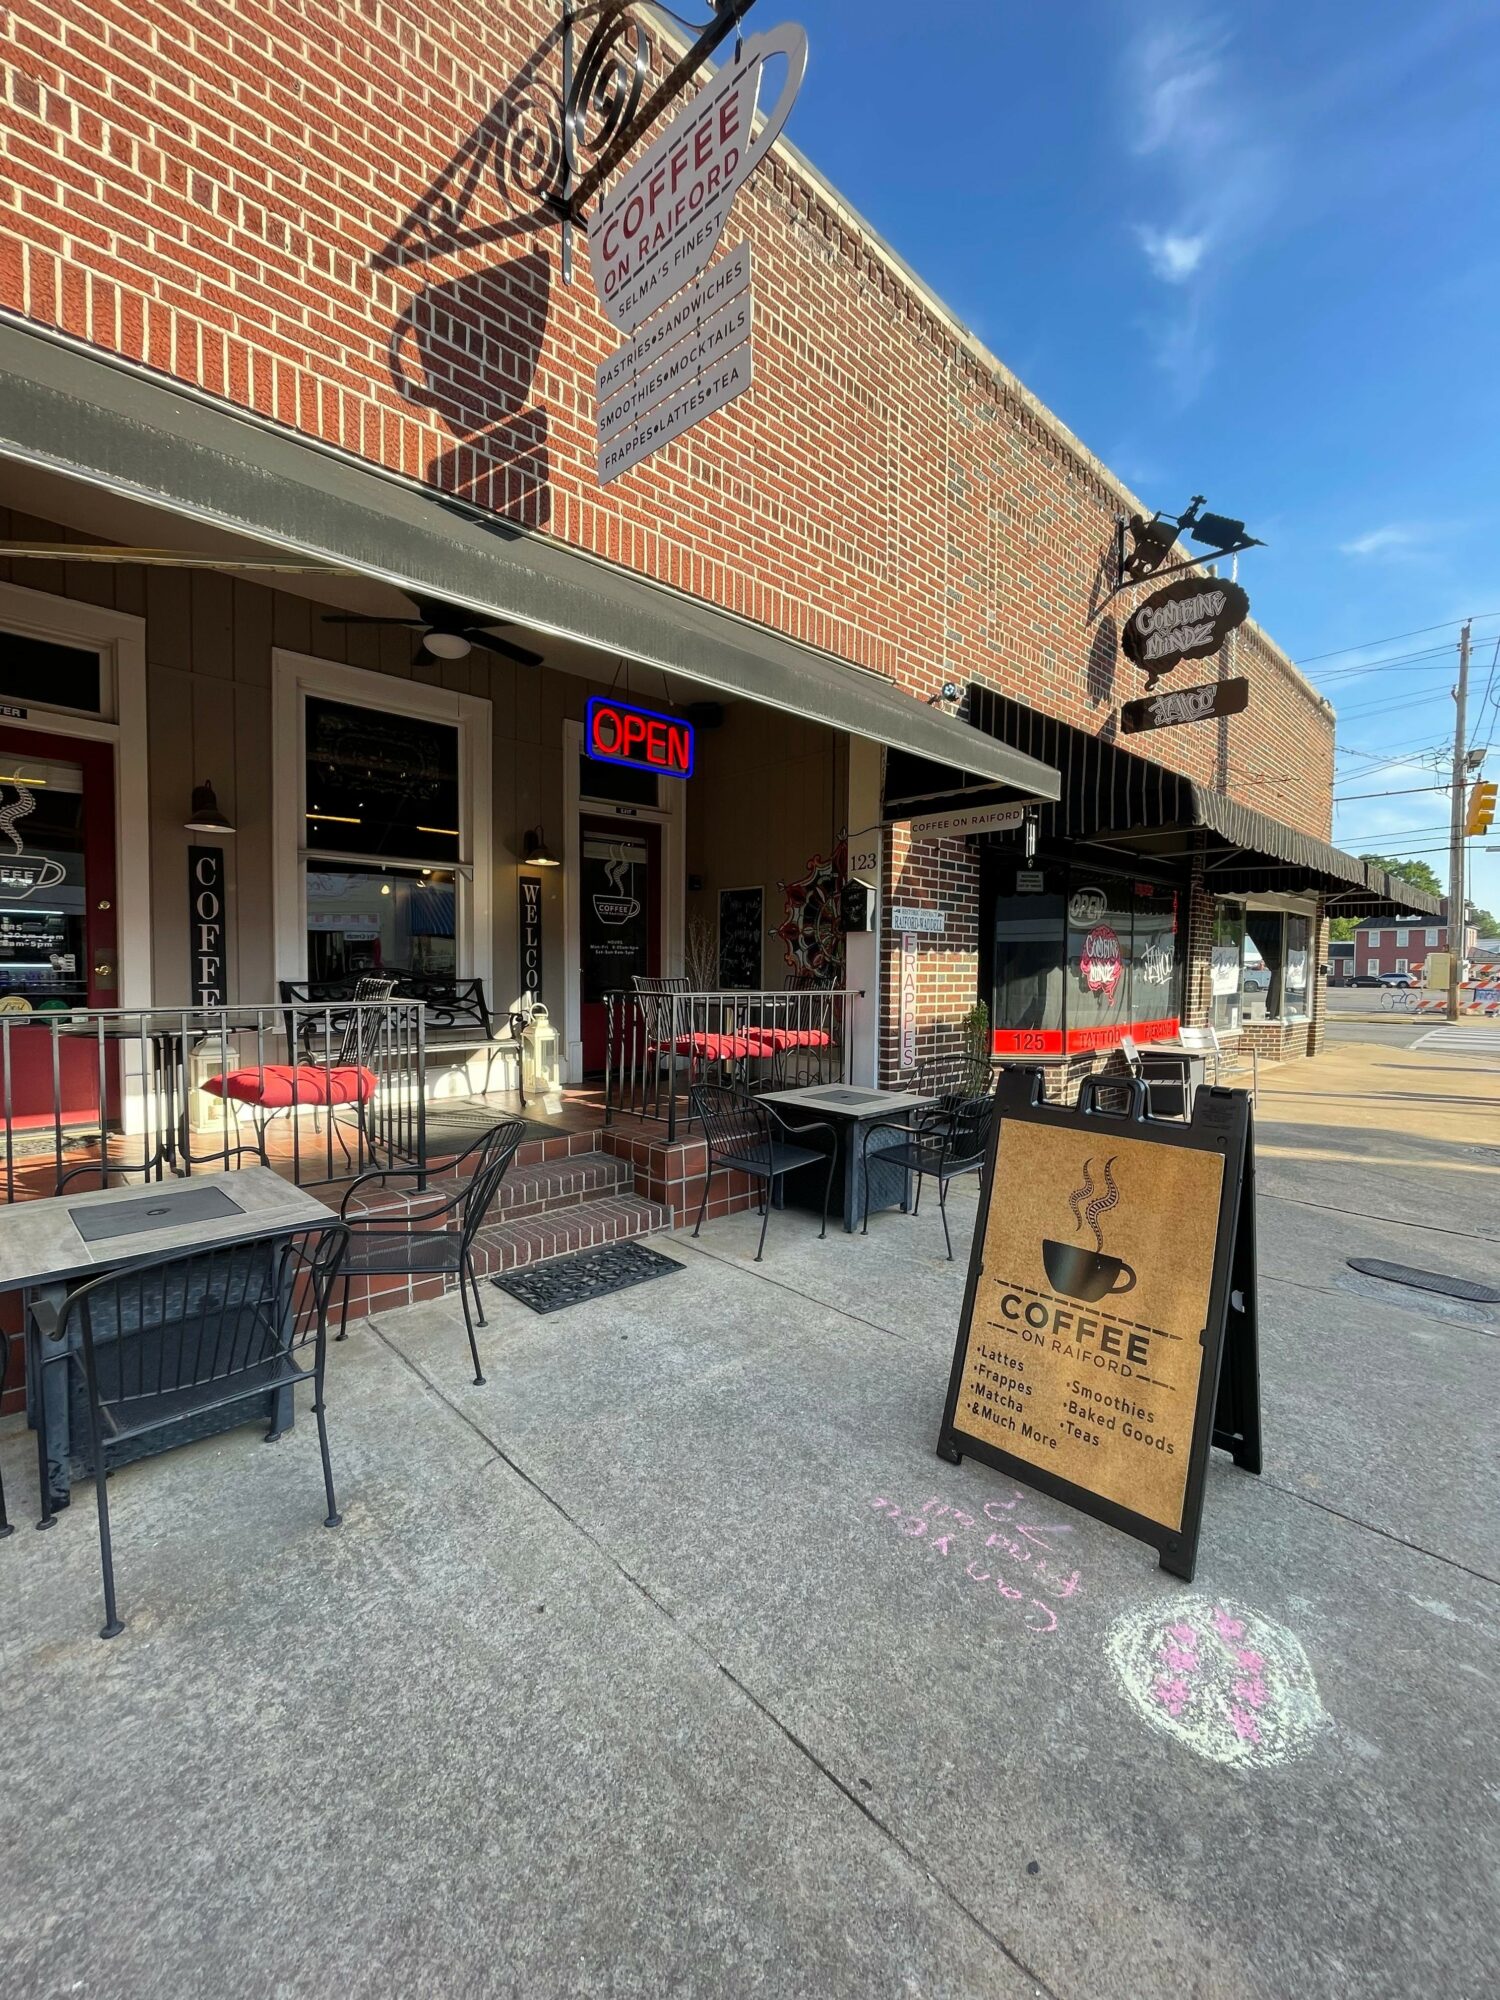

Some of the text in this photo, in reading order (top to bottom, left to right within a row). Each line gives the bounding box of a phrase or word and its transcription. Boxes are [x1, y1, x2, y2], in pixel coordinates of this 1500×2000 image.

[602, 90, 740, 263] COFFEE
[603, 147, 739, 295] ON RAIFORD
[618, 211, 723, 317] SELMA'S FINEST
[1136, 590, 1227, 636] COMBINE
[1148, 684, 1218, 726] TATTOO
[593, 708, 690, 769] OPEN
[912, 810, 1020, 832] COFFEE ON RAIFORD
[851, 854, 877, 871] 123
[599, 905, 628, 913] COFFEE
[1070, 894, 1105, 919] OPEN
[196, 857, 220, 1017] COFFE
[522, 884, 540, 1003] WELCO
[903, 934, 916, 1066] FRAPPES
[1013, 1033, 1045, 1050] 125
[1080, 1028, 1120, 1048] TATTOO
[1001, 1294, 1150, 1366] COFFEE
[981, 1345, 1024, 1372] Lattes
[1021, 1329, 1132, 1378] ON RAIFORD
[975, 1384, 1024, 1413] Matcha
[978, 1365, 1033, 1396] Frappes
[1071, 1380, 1155, 1424] Smoothies
[1021, 1422, 1057, 1449] More
[1066, 1421, 1100, 1447] Teas
[1068, 1400, 1175, 1455] Baked Goods
